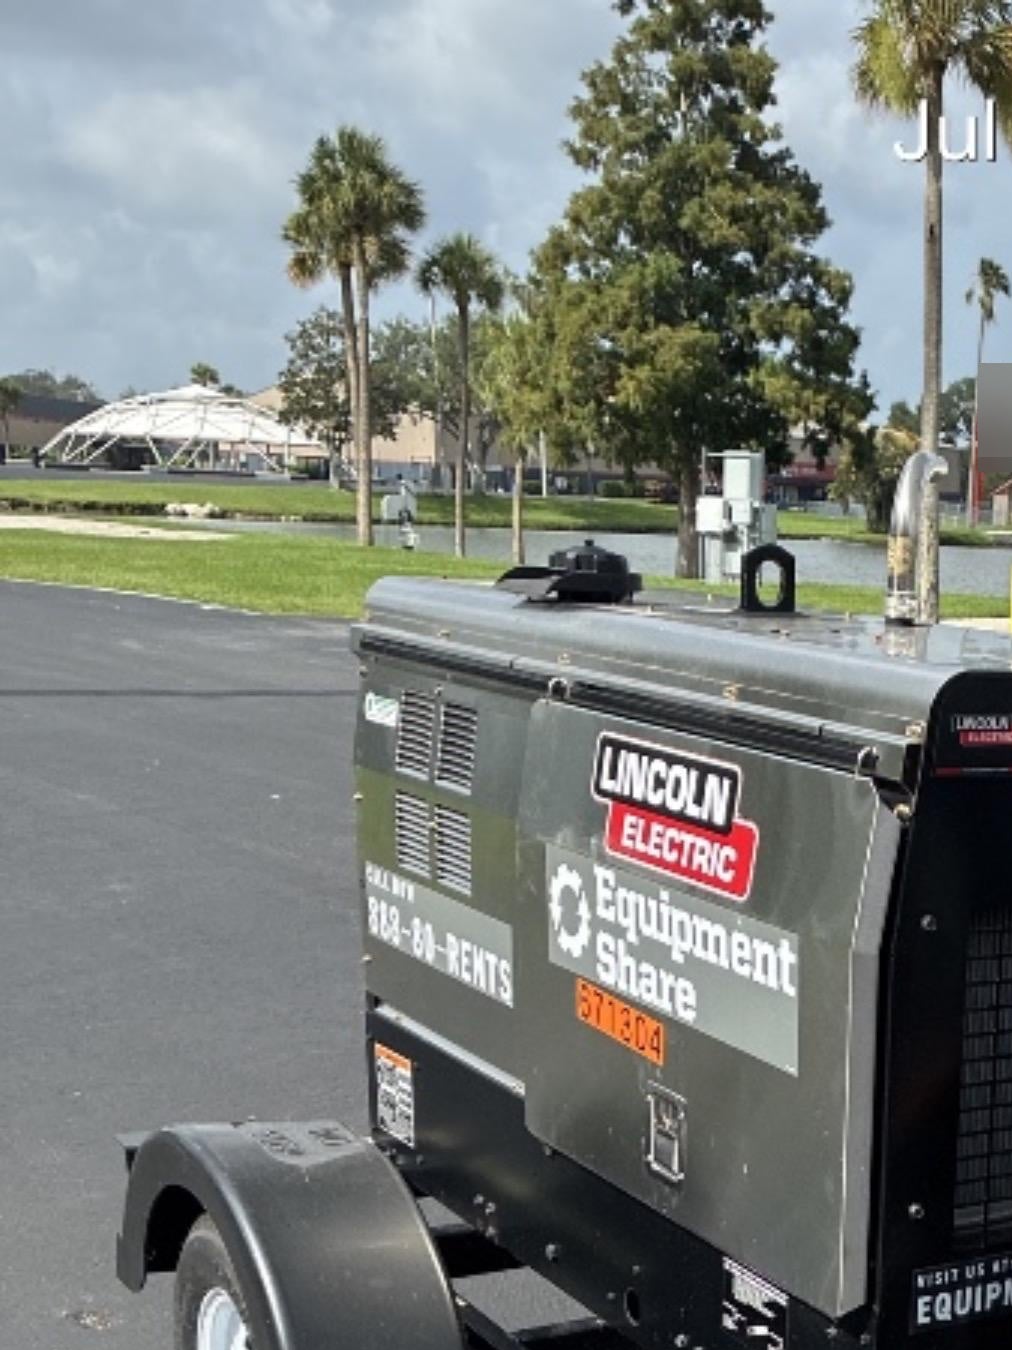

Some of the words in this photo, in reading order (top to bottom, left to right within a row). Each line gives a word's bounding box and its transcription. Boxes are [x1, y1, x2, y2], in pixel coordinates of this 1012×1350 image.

[600, 746, 732, 827] LINCOLN
[620, 813, 738, 883] ELECTRIC
[593, 864, 797, 997] Equipment
[596, 930, 698, 1024] Share
[965, 1261, 985, 1280] US
